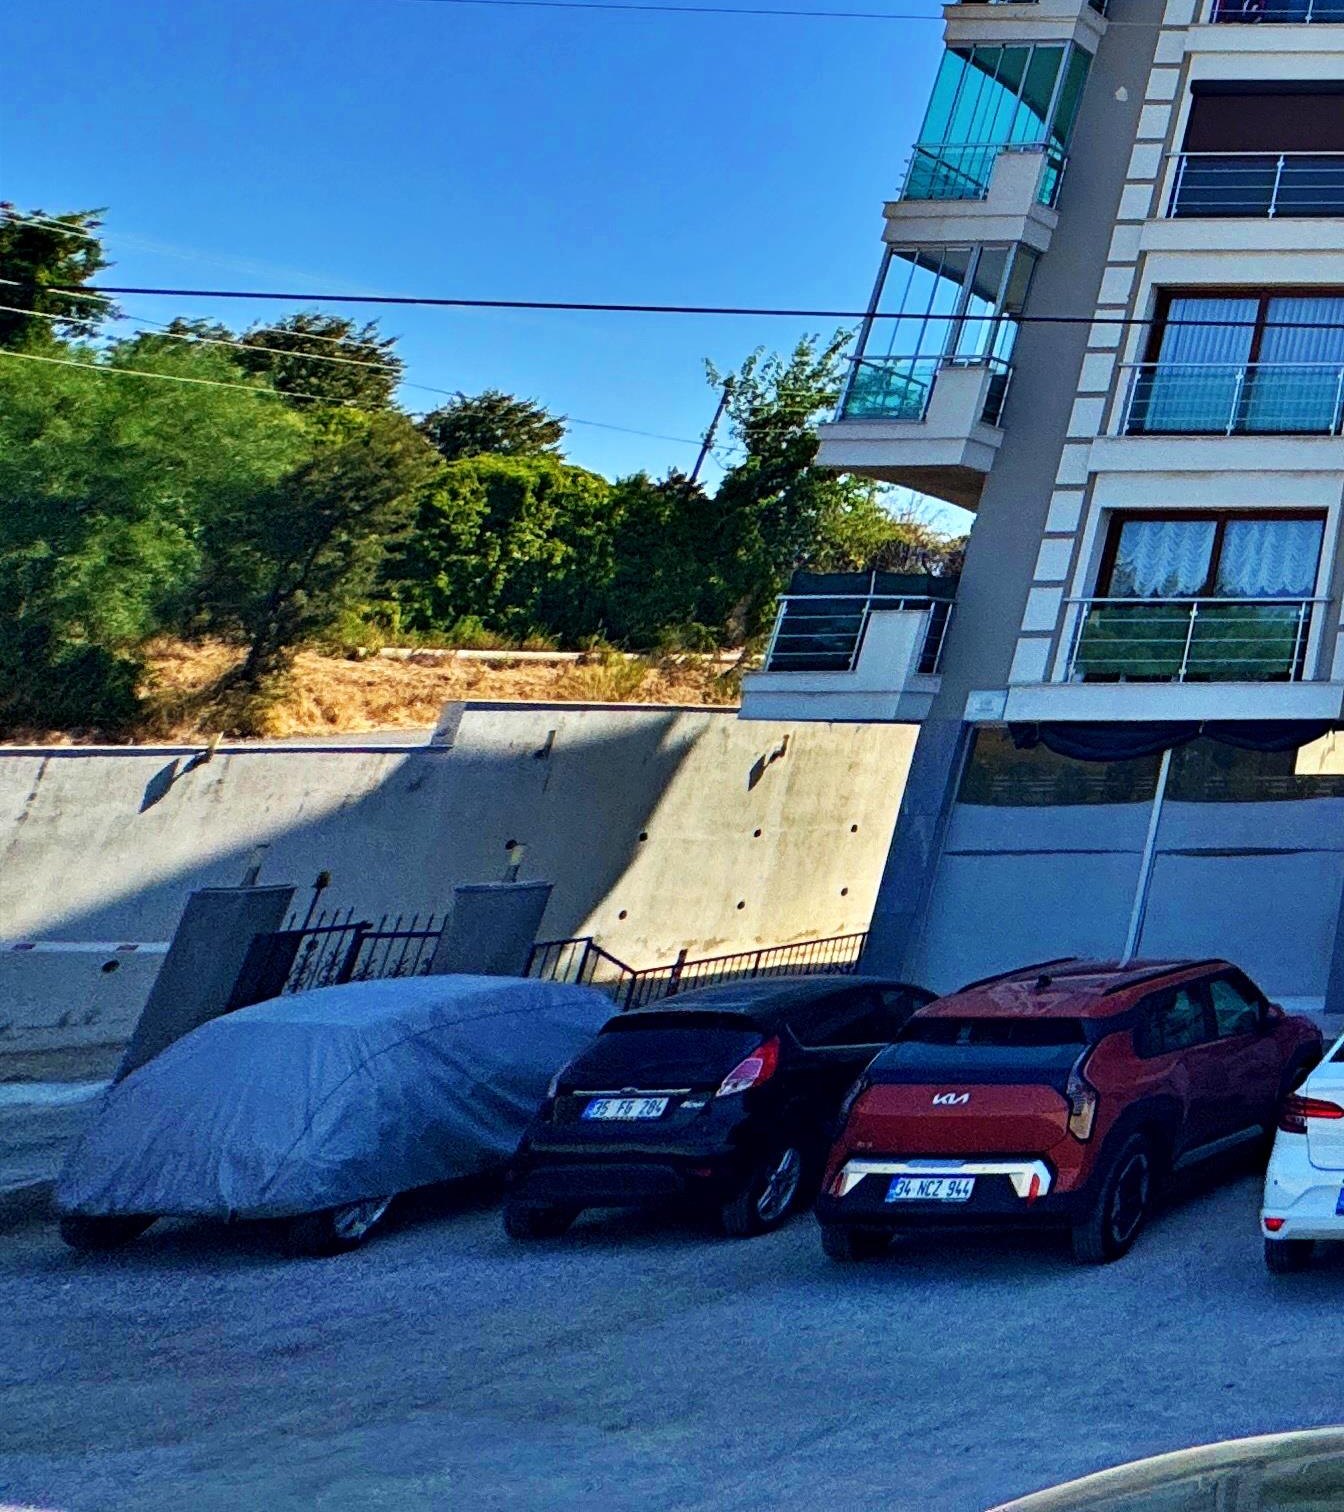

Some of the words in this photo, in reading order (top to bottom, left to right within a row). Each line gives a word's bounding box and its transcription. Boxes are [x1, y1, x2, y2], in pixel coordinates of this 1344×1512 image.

[895, 1180, 912, 1196] 34
[916, 1180, 942, 1196] NCZ
[946, 1180, 973, 1196] 944
